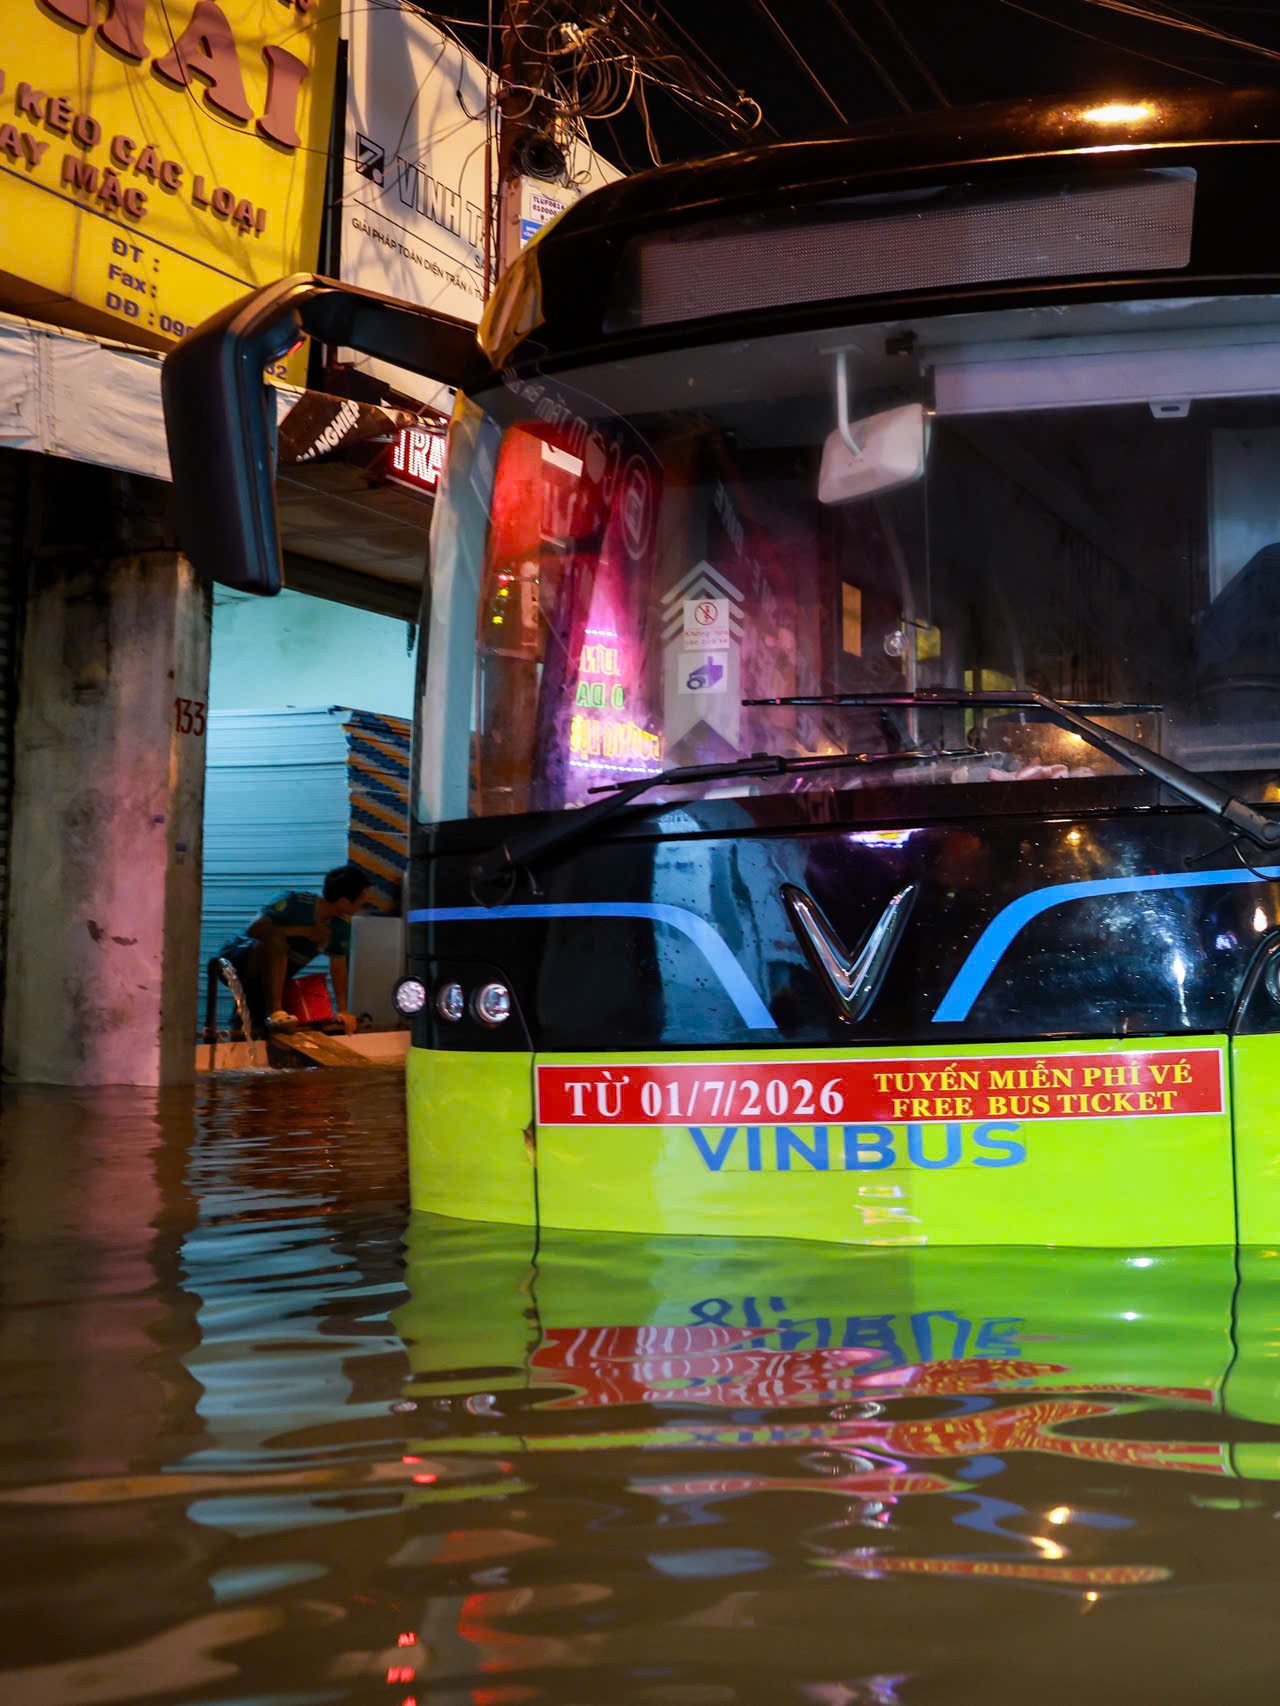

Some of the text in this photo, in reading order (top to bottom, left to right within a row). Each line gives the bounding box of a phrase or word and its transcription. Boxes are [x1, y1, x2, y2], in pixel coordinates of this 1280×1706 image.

[0, 122, 148, 220] AY MẶC
[16, 81, 267, 237] KÉO CÁC LOẠI
[111, 237, 144, 264] ĐT
[108, 263, 146, 293] Fax
[174, 697, 206, 737] 133
[564, 1070, 844, 1117] TỪ 01/7/2026
[874, 1062, 981, 1093] TUYẾN
[986, 1060, 1074, 1090] MIỄN
[1148, 1058, 1194, 1085] VÉ
[891, 1090, 1178, 1118] FREE BUS TICKET
[687, 1122, 1027, 1172] VINBUS
